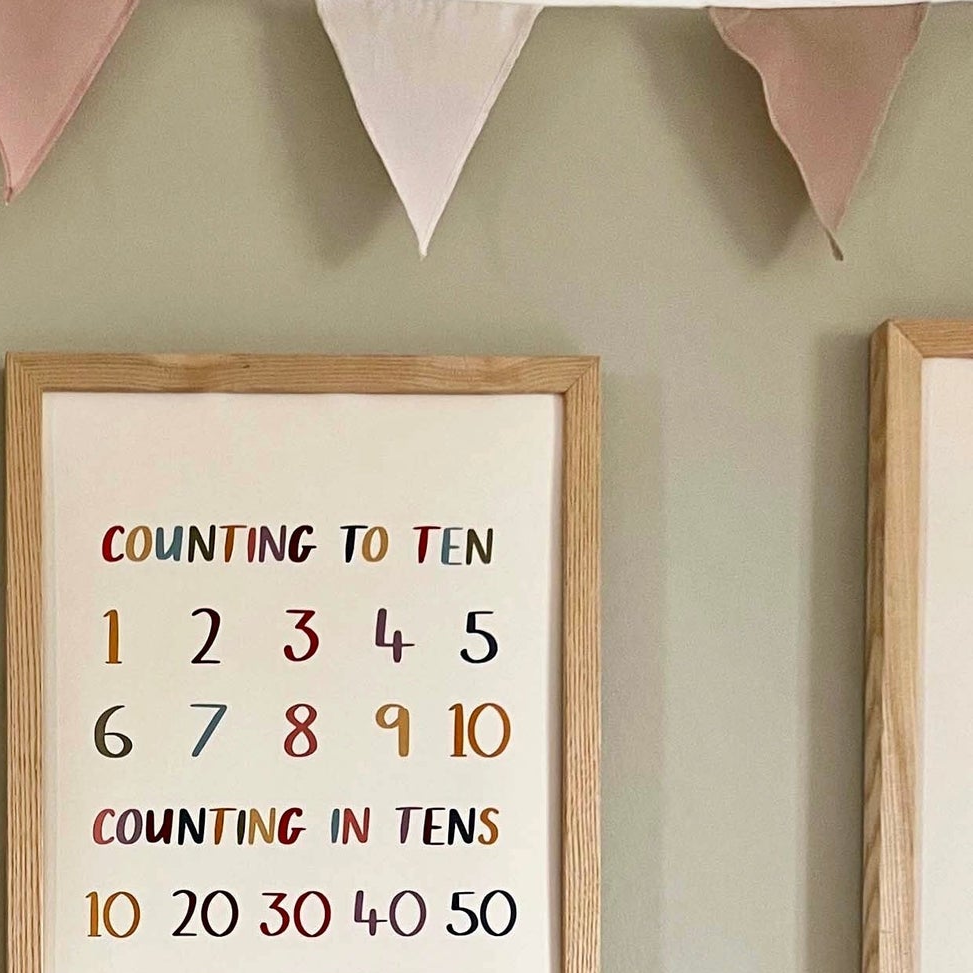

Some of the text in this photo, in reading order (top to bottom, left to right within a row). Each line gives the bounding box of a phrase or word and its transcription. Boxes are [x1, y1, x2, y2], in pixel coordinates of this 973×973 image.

[101, 523, 495, 566] COUNTING TO TEN
[102, 607, 500, 665] 1 2 3 4 5
[92, 702, 512, 760] 6 7 8 9 10
[92, 805, 500, 847] COUNTING IN TENS
[84, 888, 518, 939] 10 20 30 40 50
